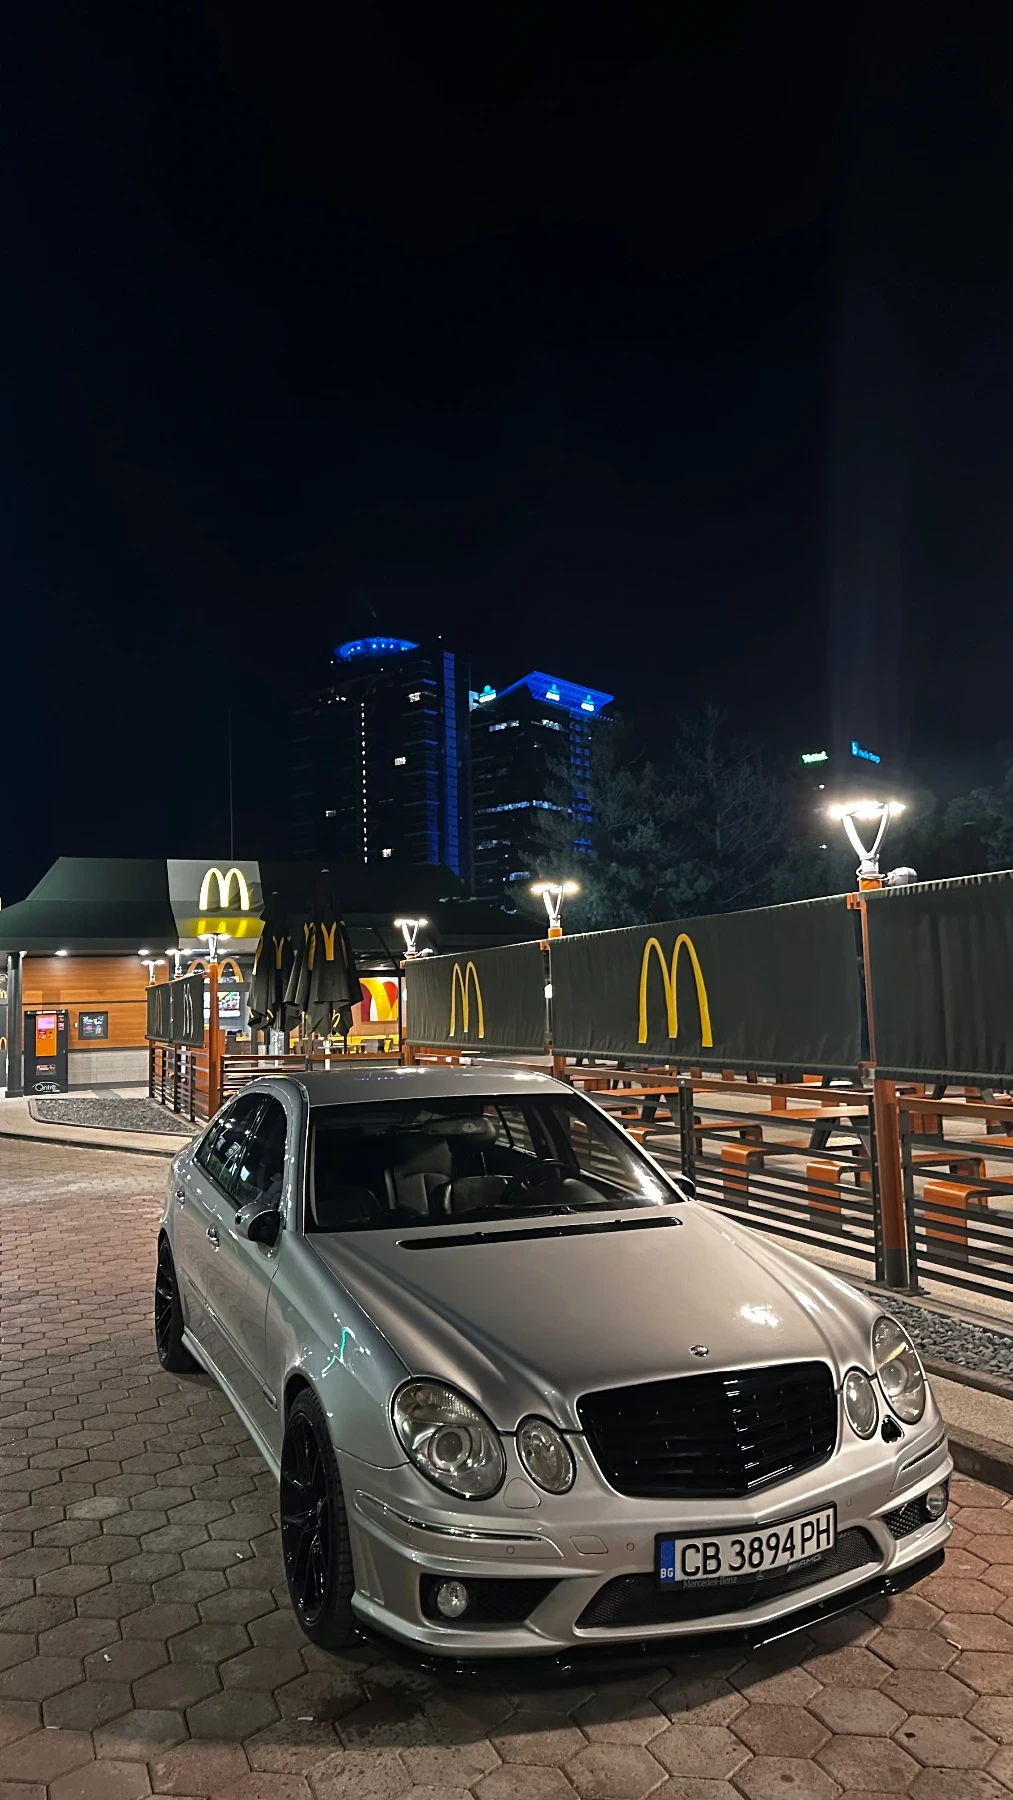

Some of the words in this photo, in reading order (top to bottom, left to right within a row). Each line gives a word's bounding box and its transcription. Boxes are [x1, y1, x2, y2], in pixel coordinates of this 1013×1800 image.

[681, 1541, 721, 1577] CB
[729, 1526, 795, 1572] 3894
[800, 1513, 831, 1556] PH
[660, 1567, 674, 1579] BG
[683, 1576, 738, 1588] Mercedes-Benz
